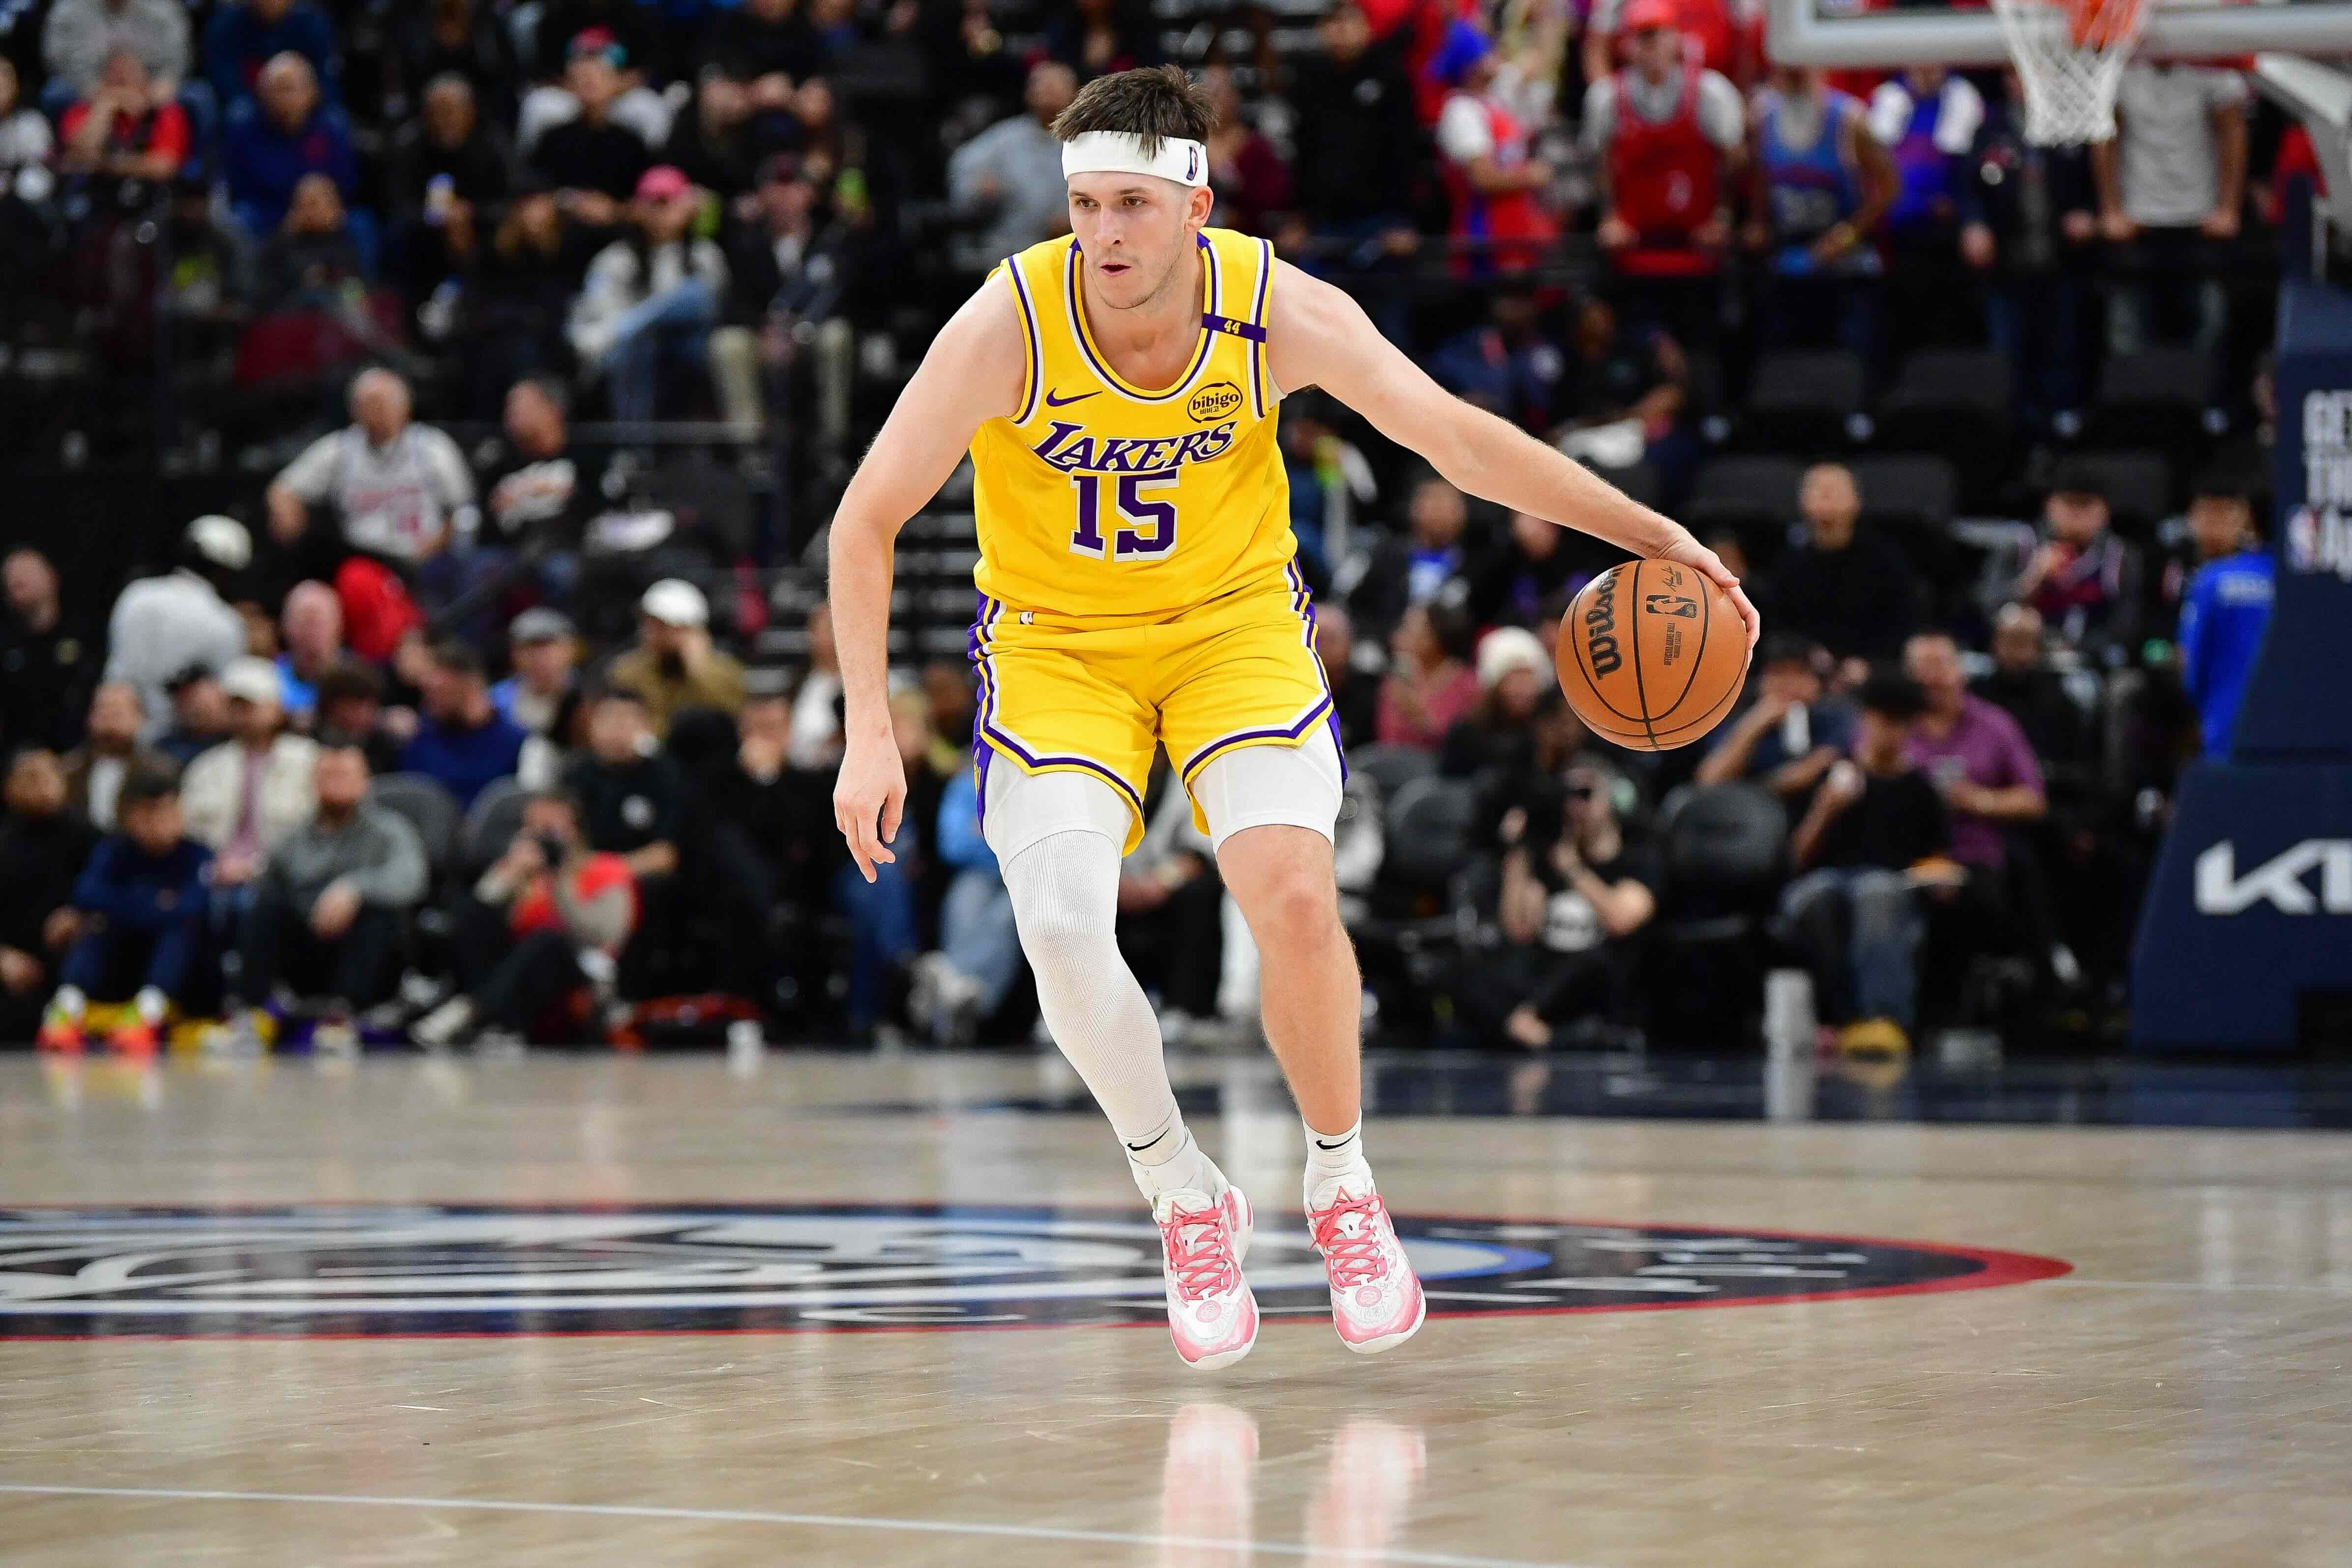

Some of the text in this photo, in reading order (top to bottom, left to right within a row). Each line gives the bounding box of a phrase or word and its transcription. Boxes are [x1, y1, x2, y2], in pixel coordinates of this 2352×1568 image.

[1224, 320, 1241, 334] 44
[1192, 392, 1239, 410] bibigo
[1028, 420, 1238, 473] LAKERS
[1069, 467, 1179, 562] 15
